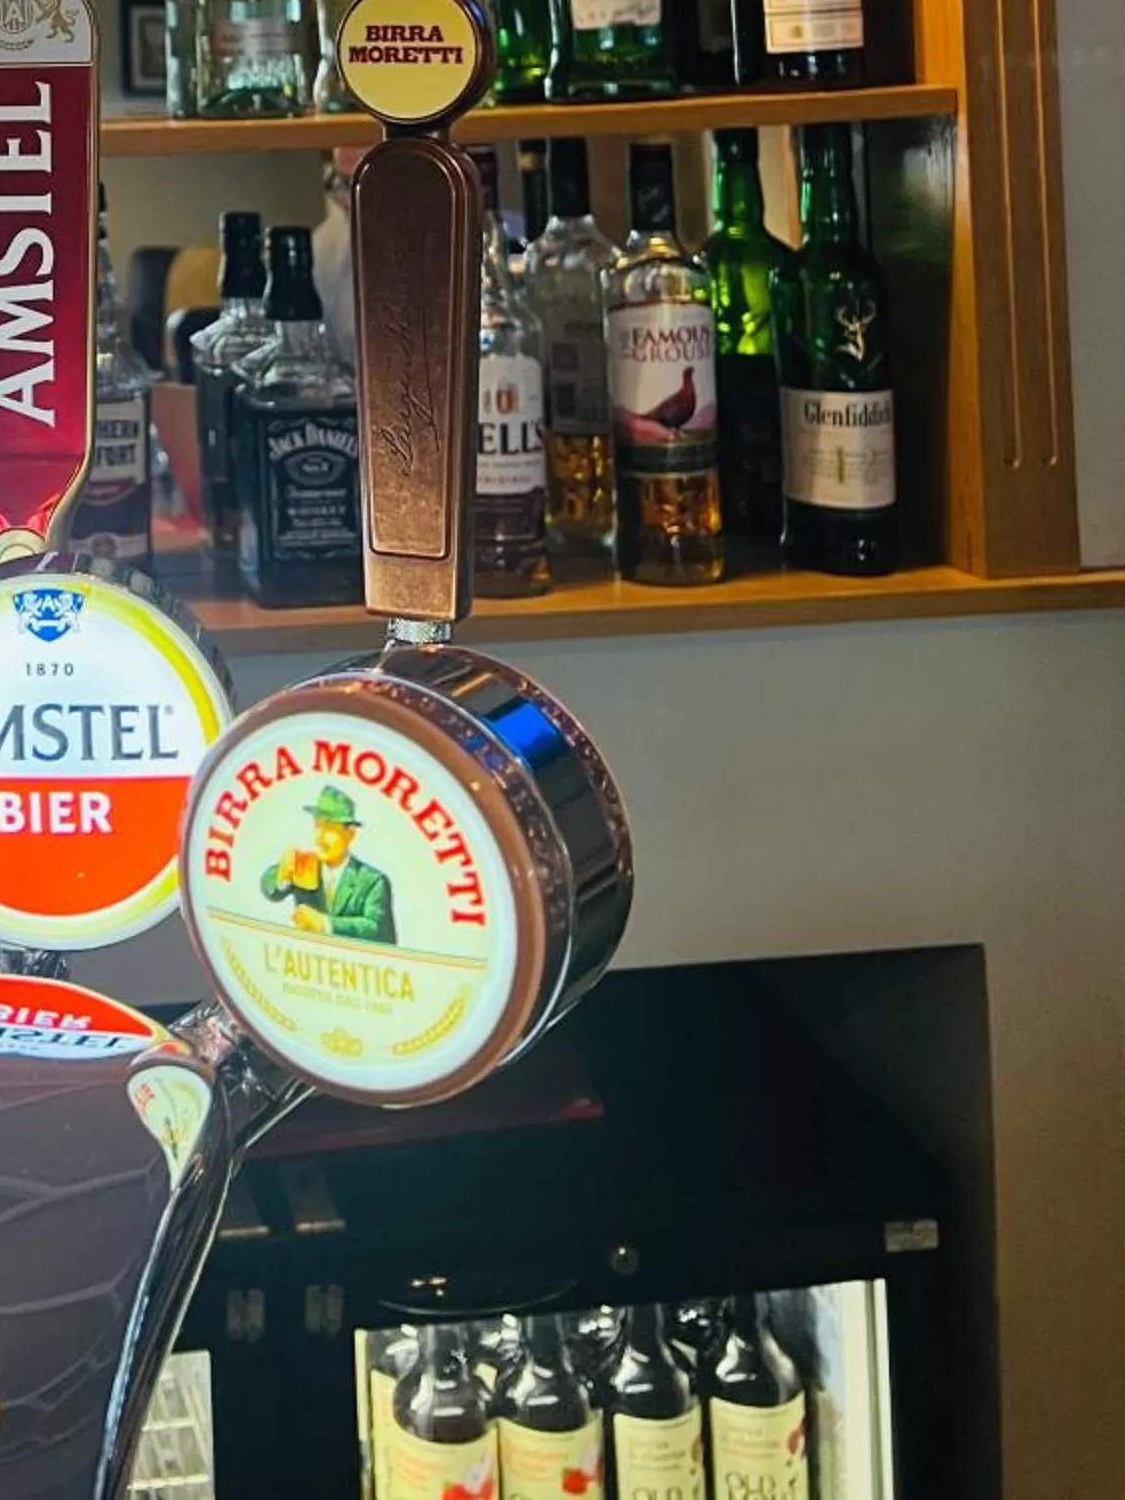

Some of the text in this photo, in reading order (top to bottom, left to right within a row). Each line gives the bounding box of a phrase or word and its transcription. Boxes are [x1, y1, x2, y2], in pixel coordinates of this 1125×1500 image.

[365, 25, 444, 42] BIRRA
[348, 46, 464, 64] MORETTI
[477, 419, 545, 455] ELL'S
[26, 662, 75, 677] 1870
[205, 739, 487, 928] BIRRA MORETTI
[263, 943, 416, 1002] L'AUTENTICA
